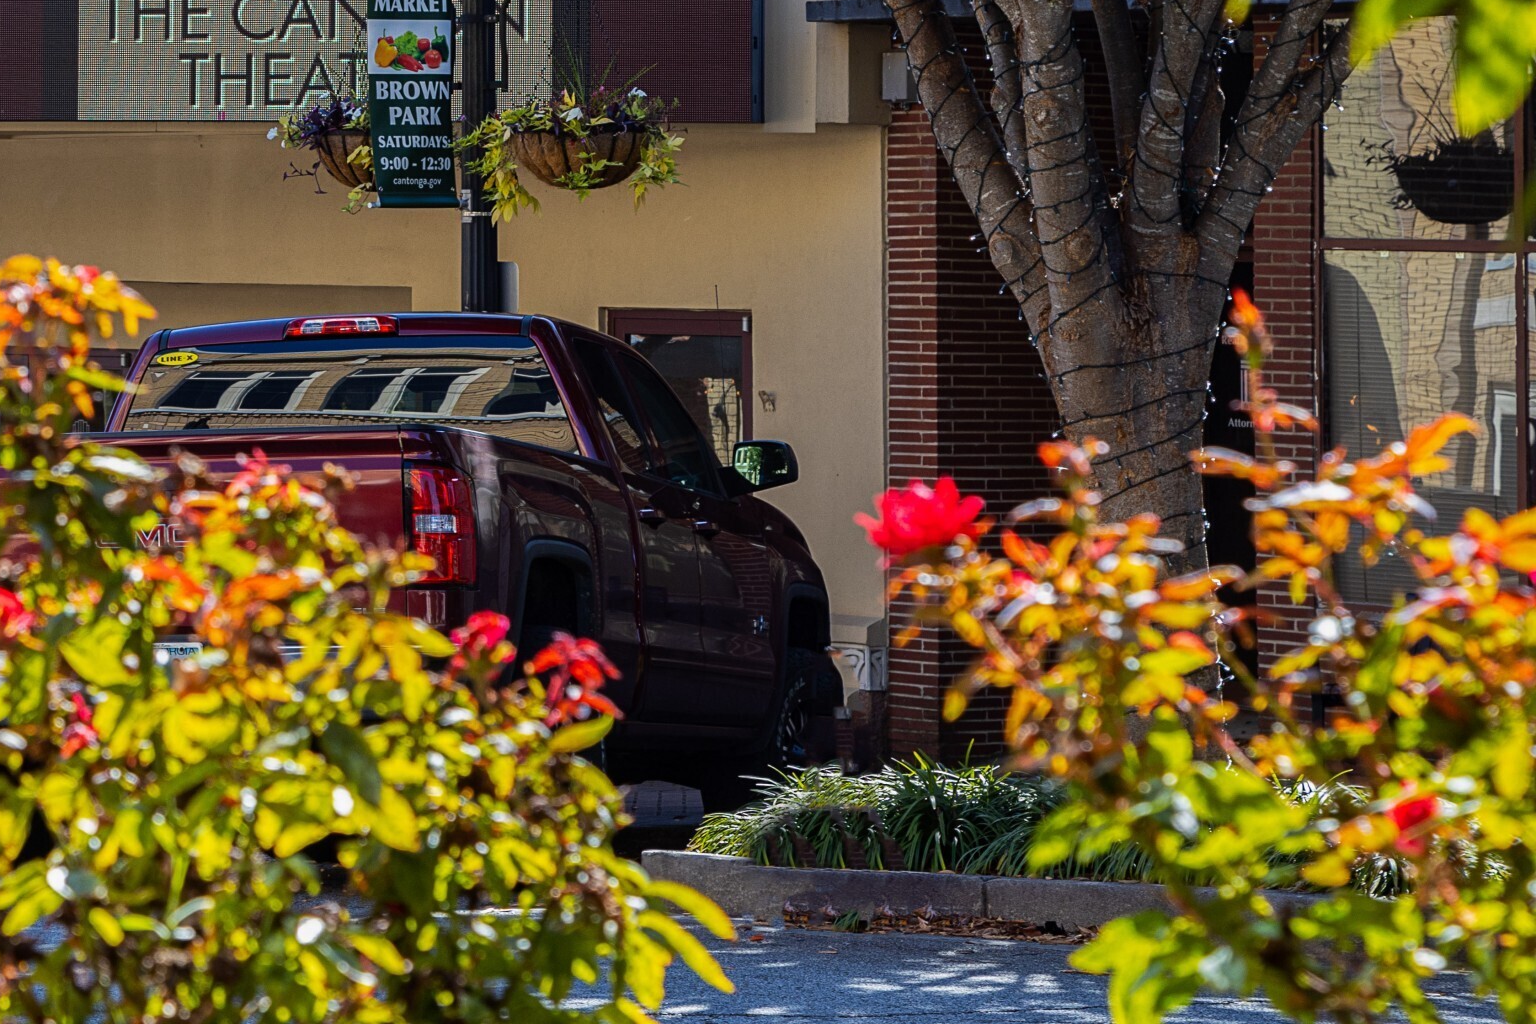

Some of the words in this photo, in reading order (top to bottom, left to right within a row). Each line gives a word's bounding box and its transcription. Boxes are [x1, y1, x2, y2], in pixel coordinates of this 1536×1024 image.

[375, 80, 450, 101] BROWN
[388, 106, 442, 126] PARK
[380, 156, 409, 171] 9:00
[421, 157, 451, 171] 12:30
[393, 177, 442, 189] cantonga.gov
[1227, 417, 1256, 428] Attorn
